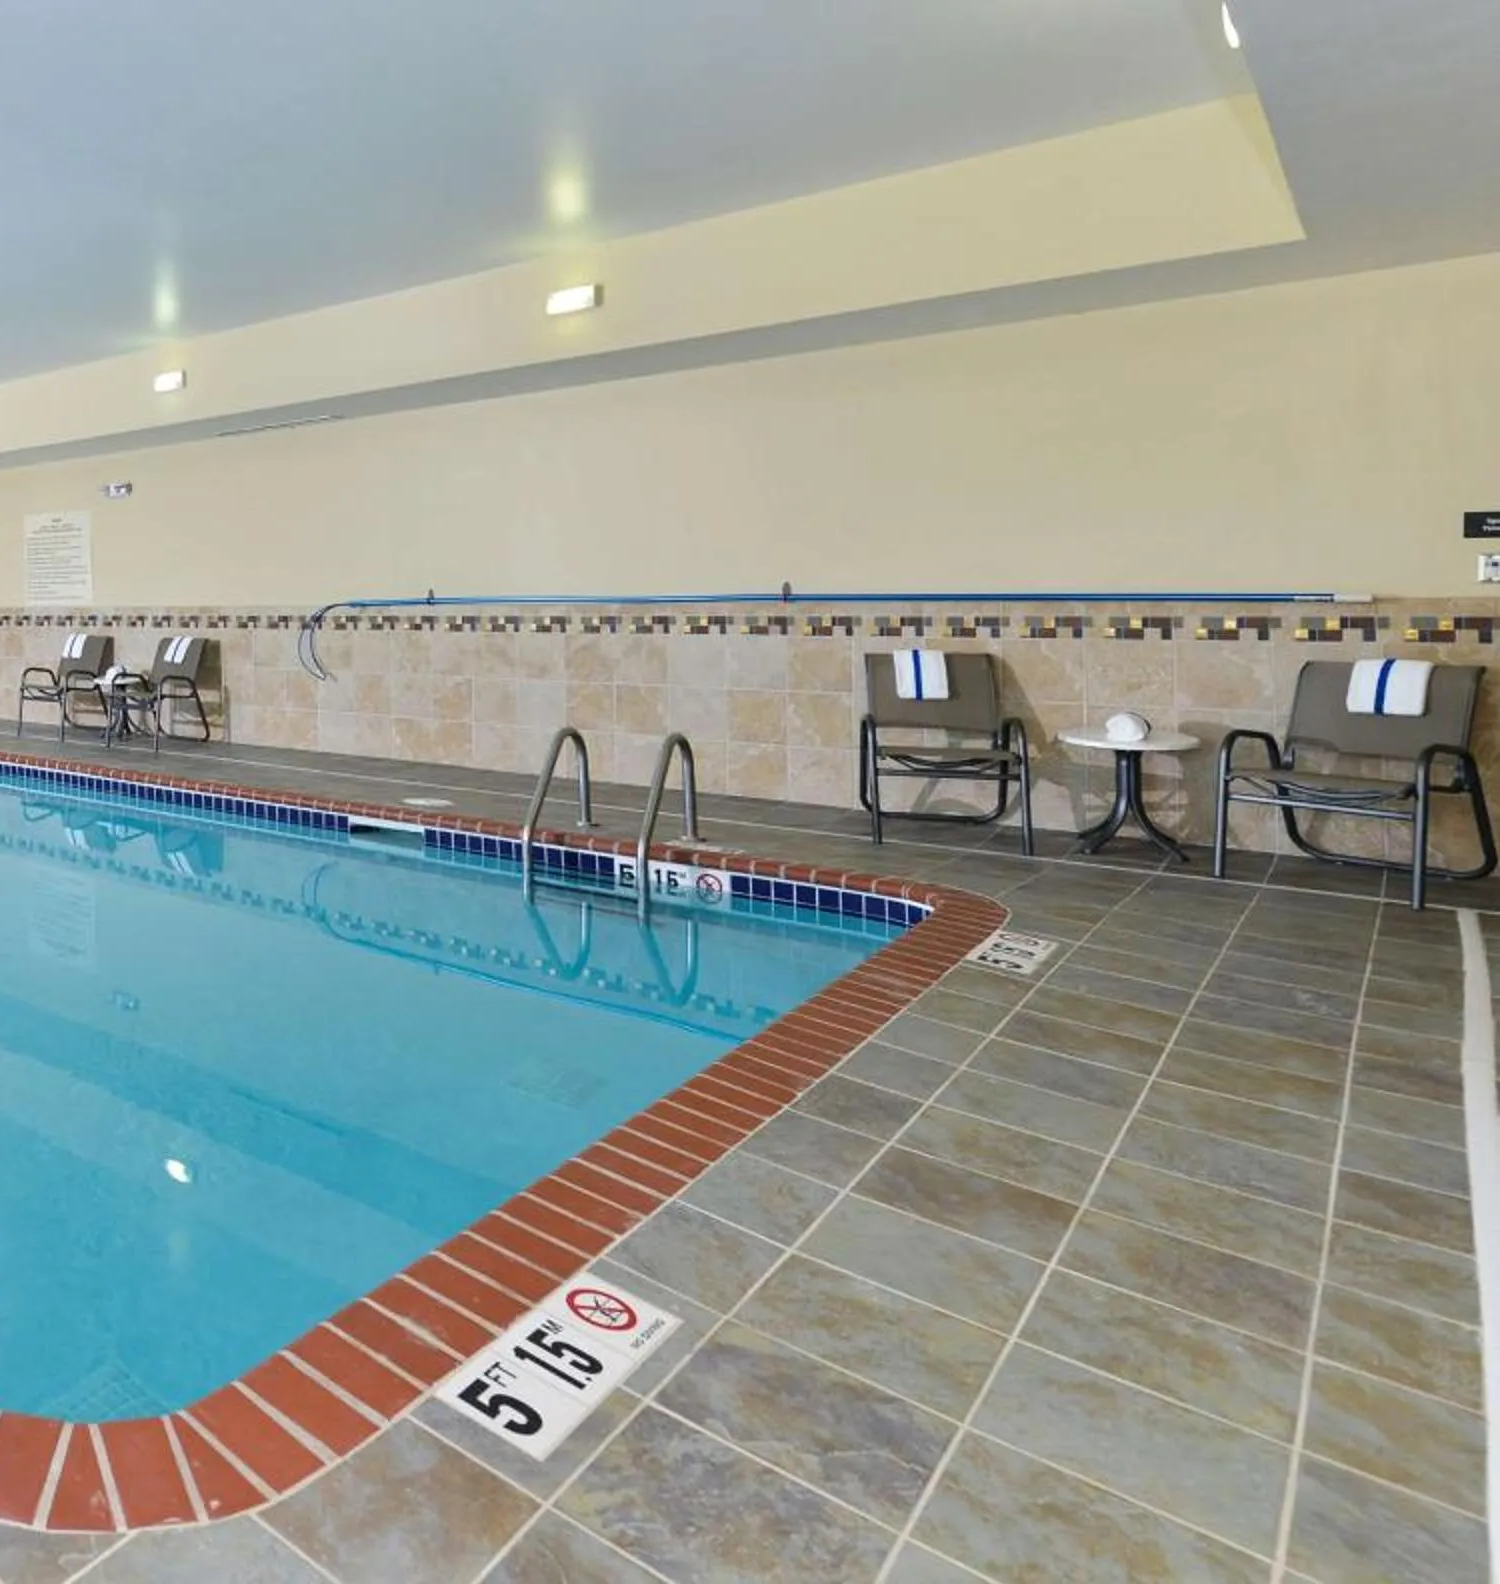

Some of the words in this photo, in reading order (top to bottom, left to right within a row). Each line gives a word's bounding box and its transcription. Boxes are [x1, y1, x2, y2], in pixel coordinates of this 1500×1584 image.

[540, 1319, 565, 1335] M
[484, 1361, 517, 1388] FT
[512, 1327, 604, 1391] 1.5
[457, 1377, 544, 1437] 5
